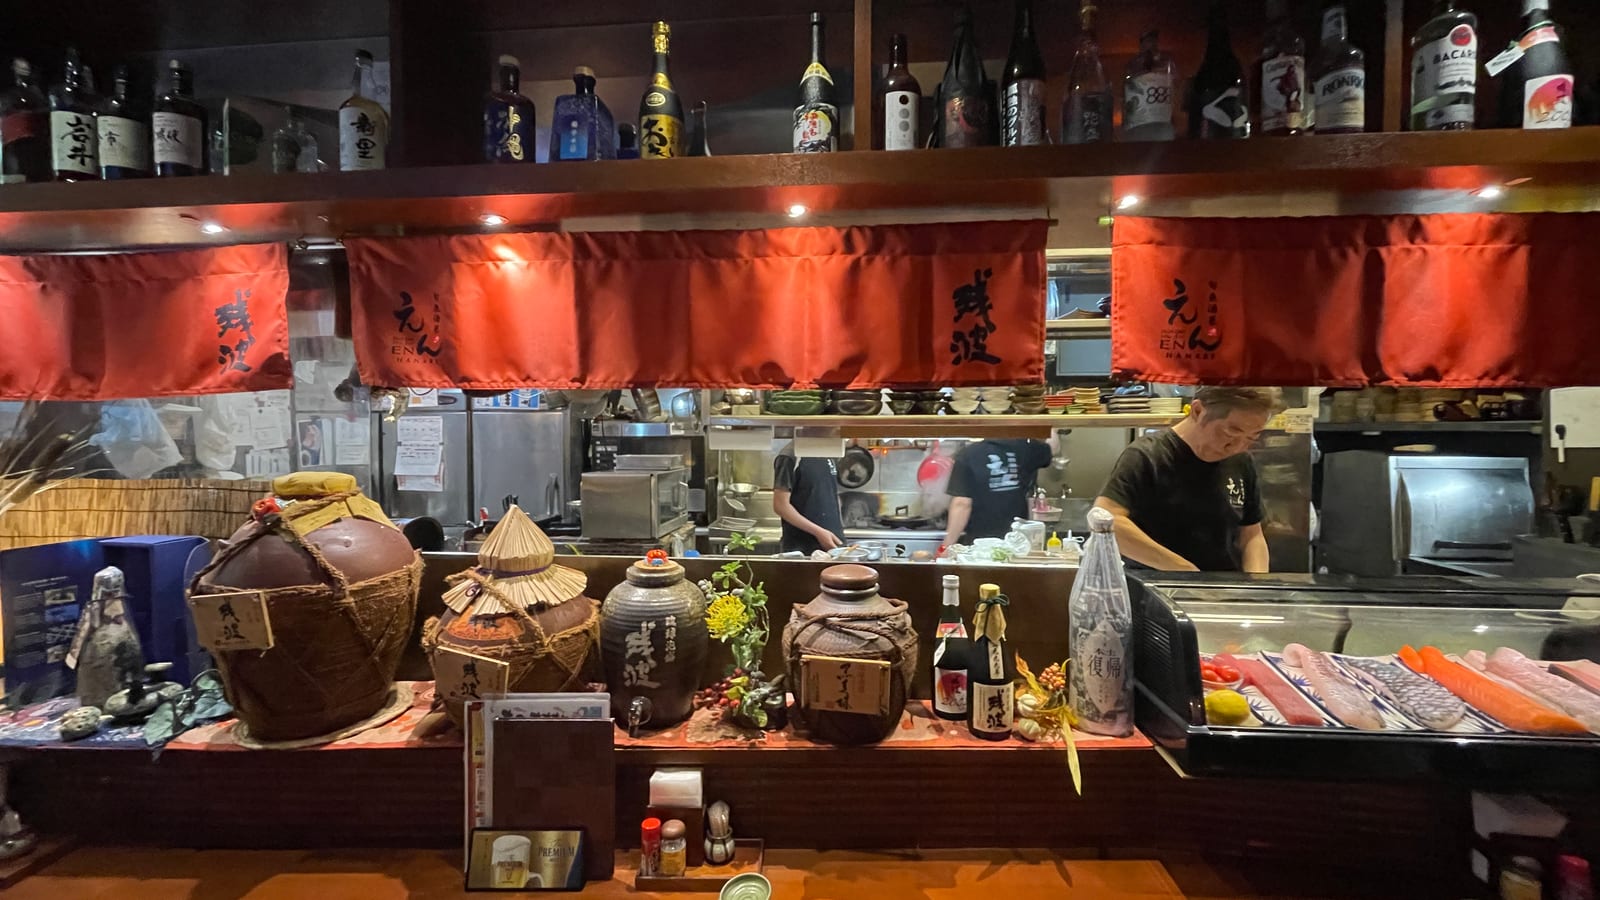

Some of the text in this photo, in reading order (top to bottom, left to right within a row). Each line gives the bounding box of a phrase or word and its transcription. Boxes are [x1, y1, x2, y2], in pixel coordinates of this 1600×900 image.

[1433, 49, 1476, 65] BACAR
[391, 345, 415, 355] EN
[1159, 339, 1186, 350] EN
